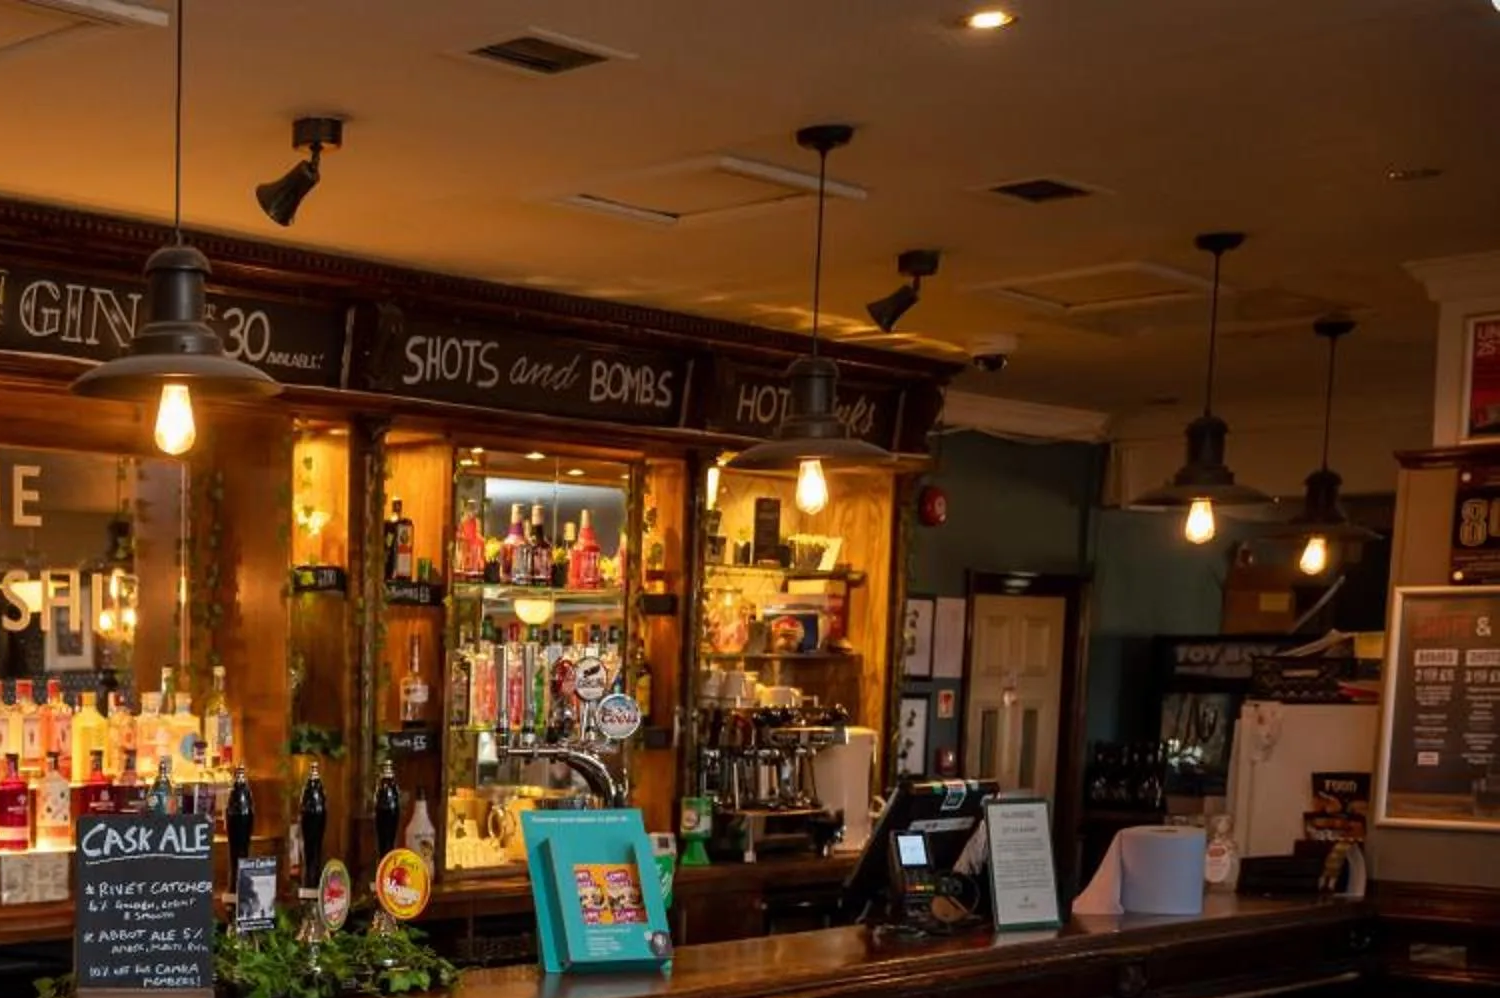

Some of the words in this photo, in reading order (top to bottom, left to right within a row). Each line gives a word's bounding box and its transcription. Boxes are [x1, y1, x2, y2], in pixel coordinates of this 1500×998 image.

[222, 307, 270, 361] 30
[403, 335, 499, 388] SHOTS
[509, 353, 581, 392] and
[589, 358, 674, 408] BOMBS
[736, 384, 791, 425] HOT
[81, 823, 153, 857] CASK
[159, 823, 211, 853] ALE
[99, 881, 147, 898] RIVET
[150, 881, 213, 895] CATCHER
[98, 929, 147, 942] ABBOT
[151, 929, 177, 941] ALE
